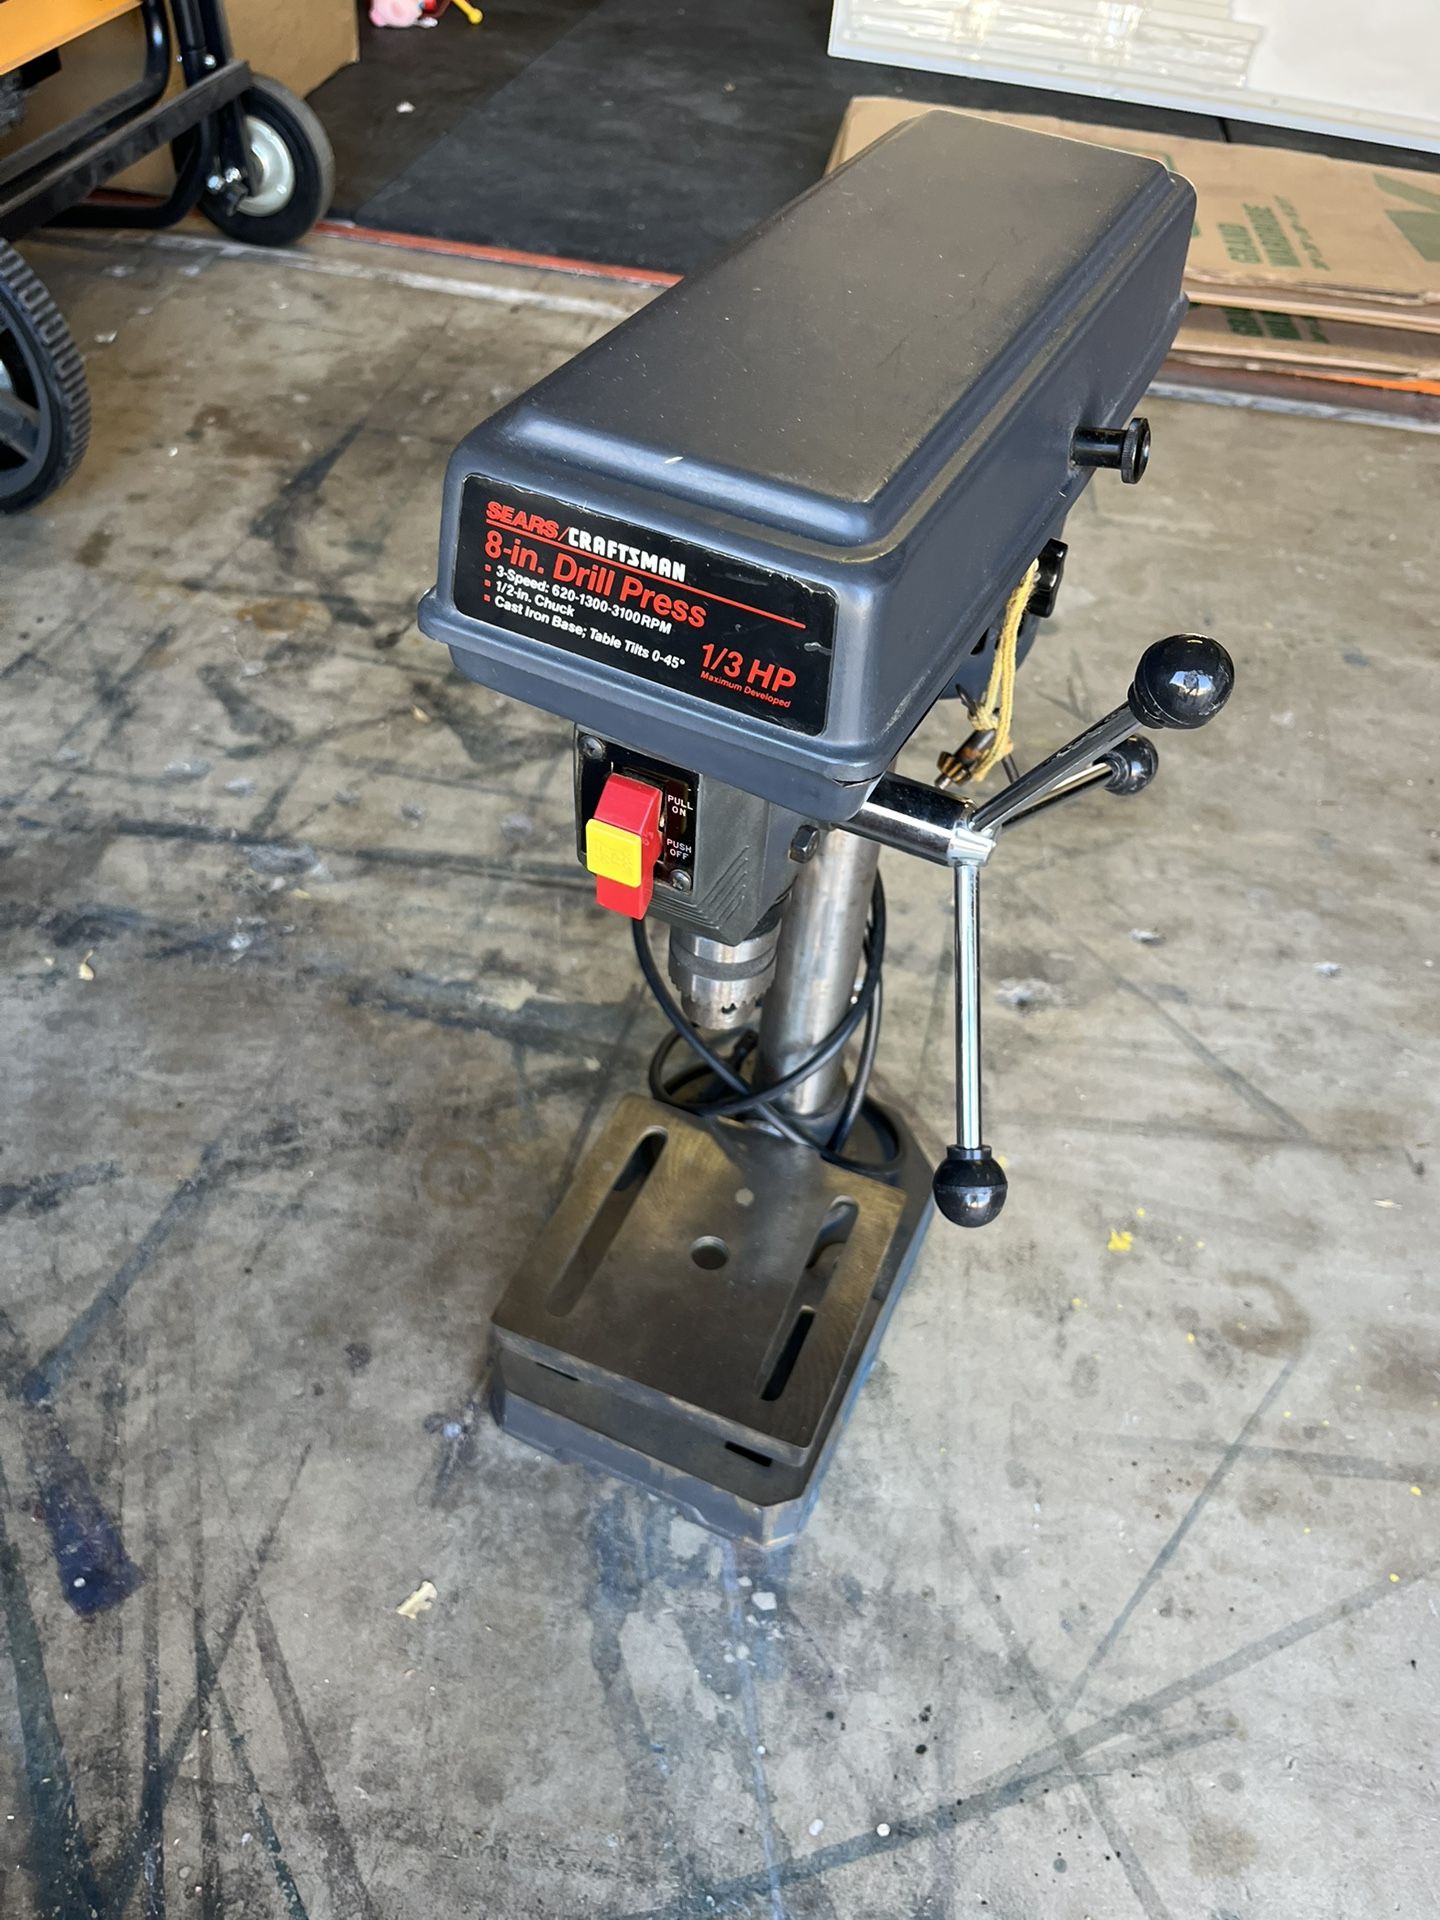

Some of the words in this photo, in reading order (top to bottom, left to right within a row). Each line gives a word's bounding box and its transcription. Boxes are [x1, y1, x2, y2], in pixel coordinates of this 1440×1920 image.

[485, 530, 544, 574] 8-in.
[553, 552, 615, 597] Drill
[619, 575, 707, 628] Press
[496, 565, 550, 594] 3-Speed:
[495, 581, 532, 603] 1/2-in.
[534, 594, 575, 617] Chuck
[494, 595, 523, 615] Cast
[524, 606, 550, 624] Iron
[551, 615, 587, 639] Base;
[590, 628, 622, 649] Table
[624, 640, 650, 657] Tilts
[651, 650, 686, 669] 0-45°
[702, 643, 744, 678] 1/3
[747, 659, 797, 693] HP
[700, 670, 742, 692] Maximum
[743, 687, 792, 709] Developed
[667, 794, 693, 811] PULL
[671, 806, 686, 817] ON
[666, 838, 692, 854] PUSH
[669, 848, 689, 860] OFF
